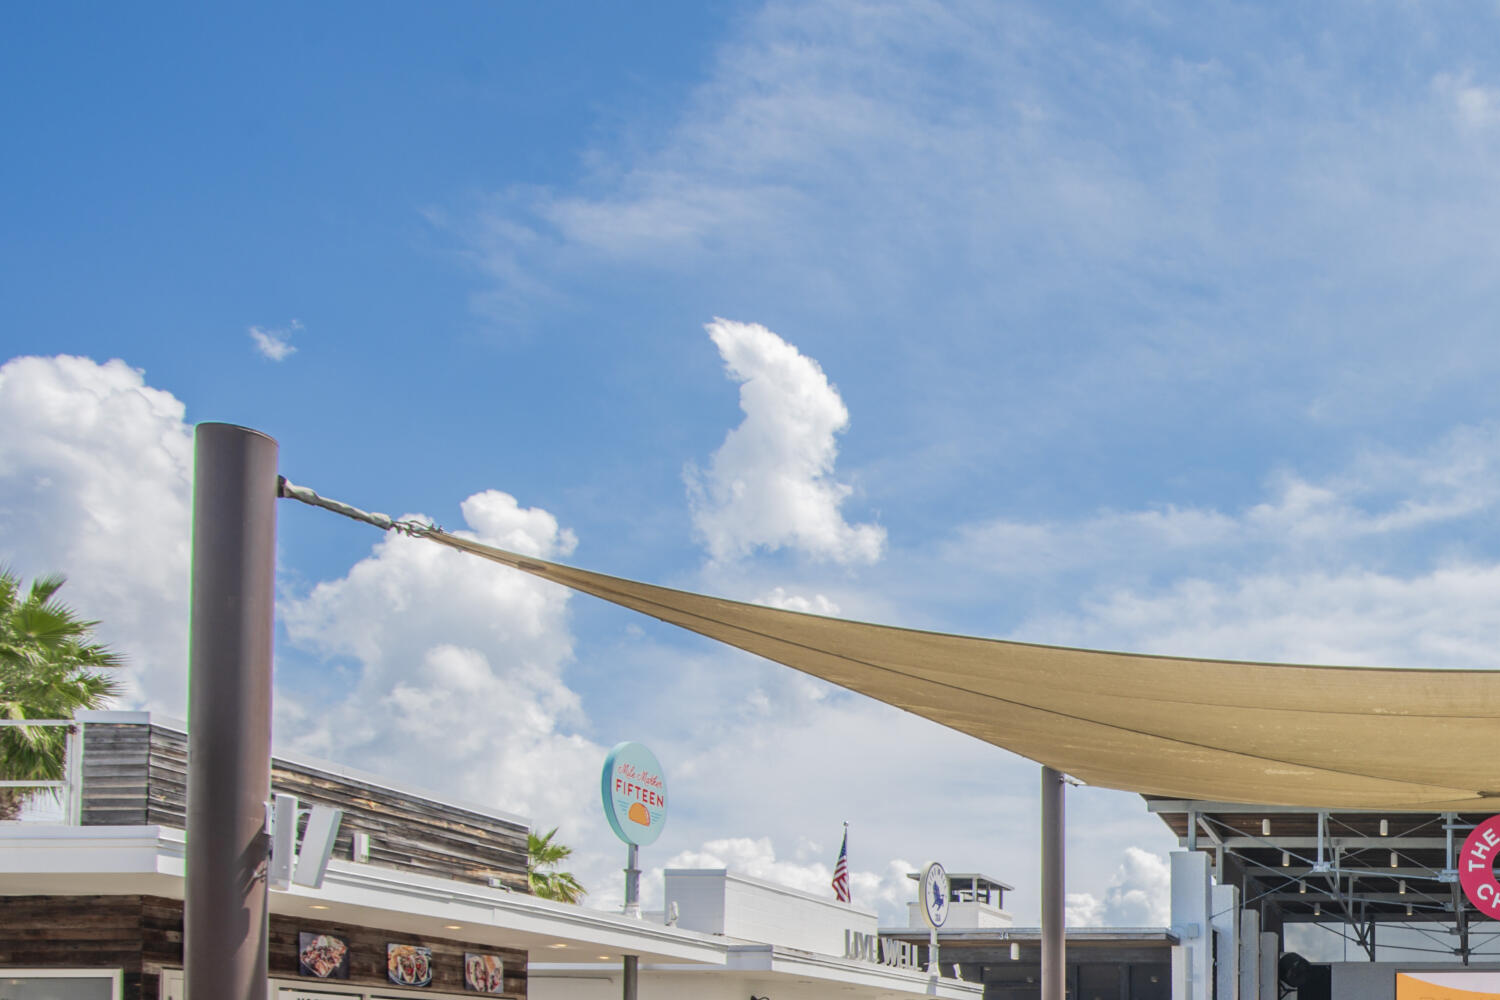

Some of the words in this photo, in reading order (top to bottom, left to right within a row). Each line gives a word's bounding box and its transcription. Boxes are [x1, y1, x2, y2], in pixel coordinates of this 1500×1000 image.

[615, 778, 664, 808] FIFTEEN
[1468, 828, 1500, 873] THE
[844, 928, 879, 964] LIVE
